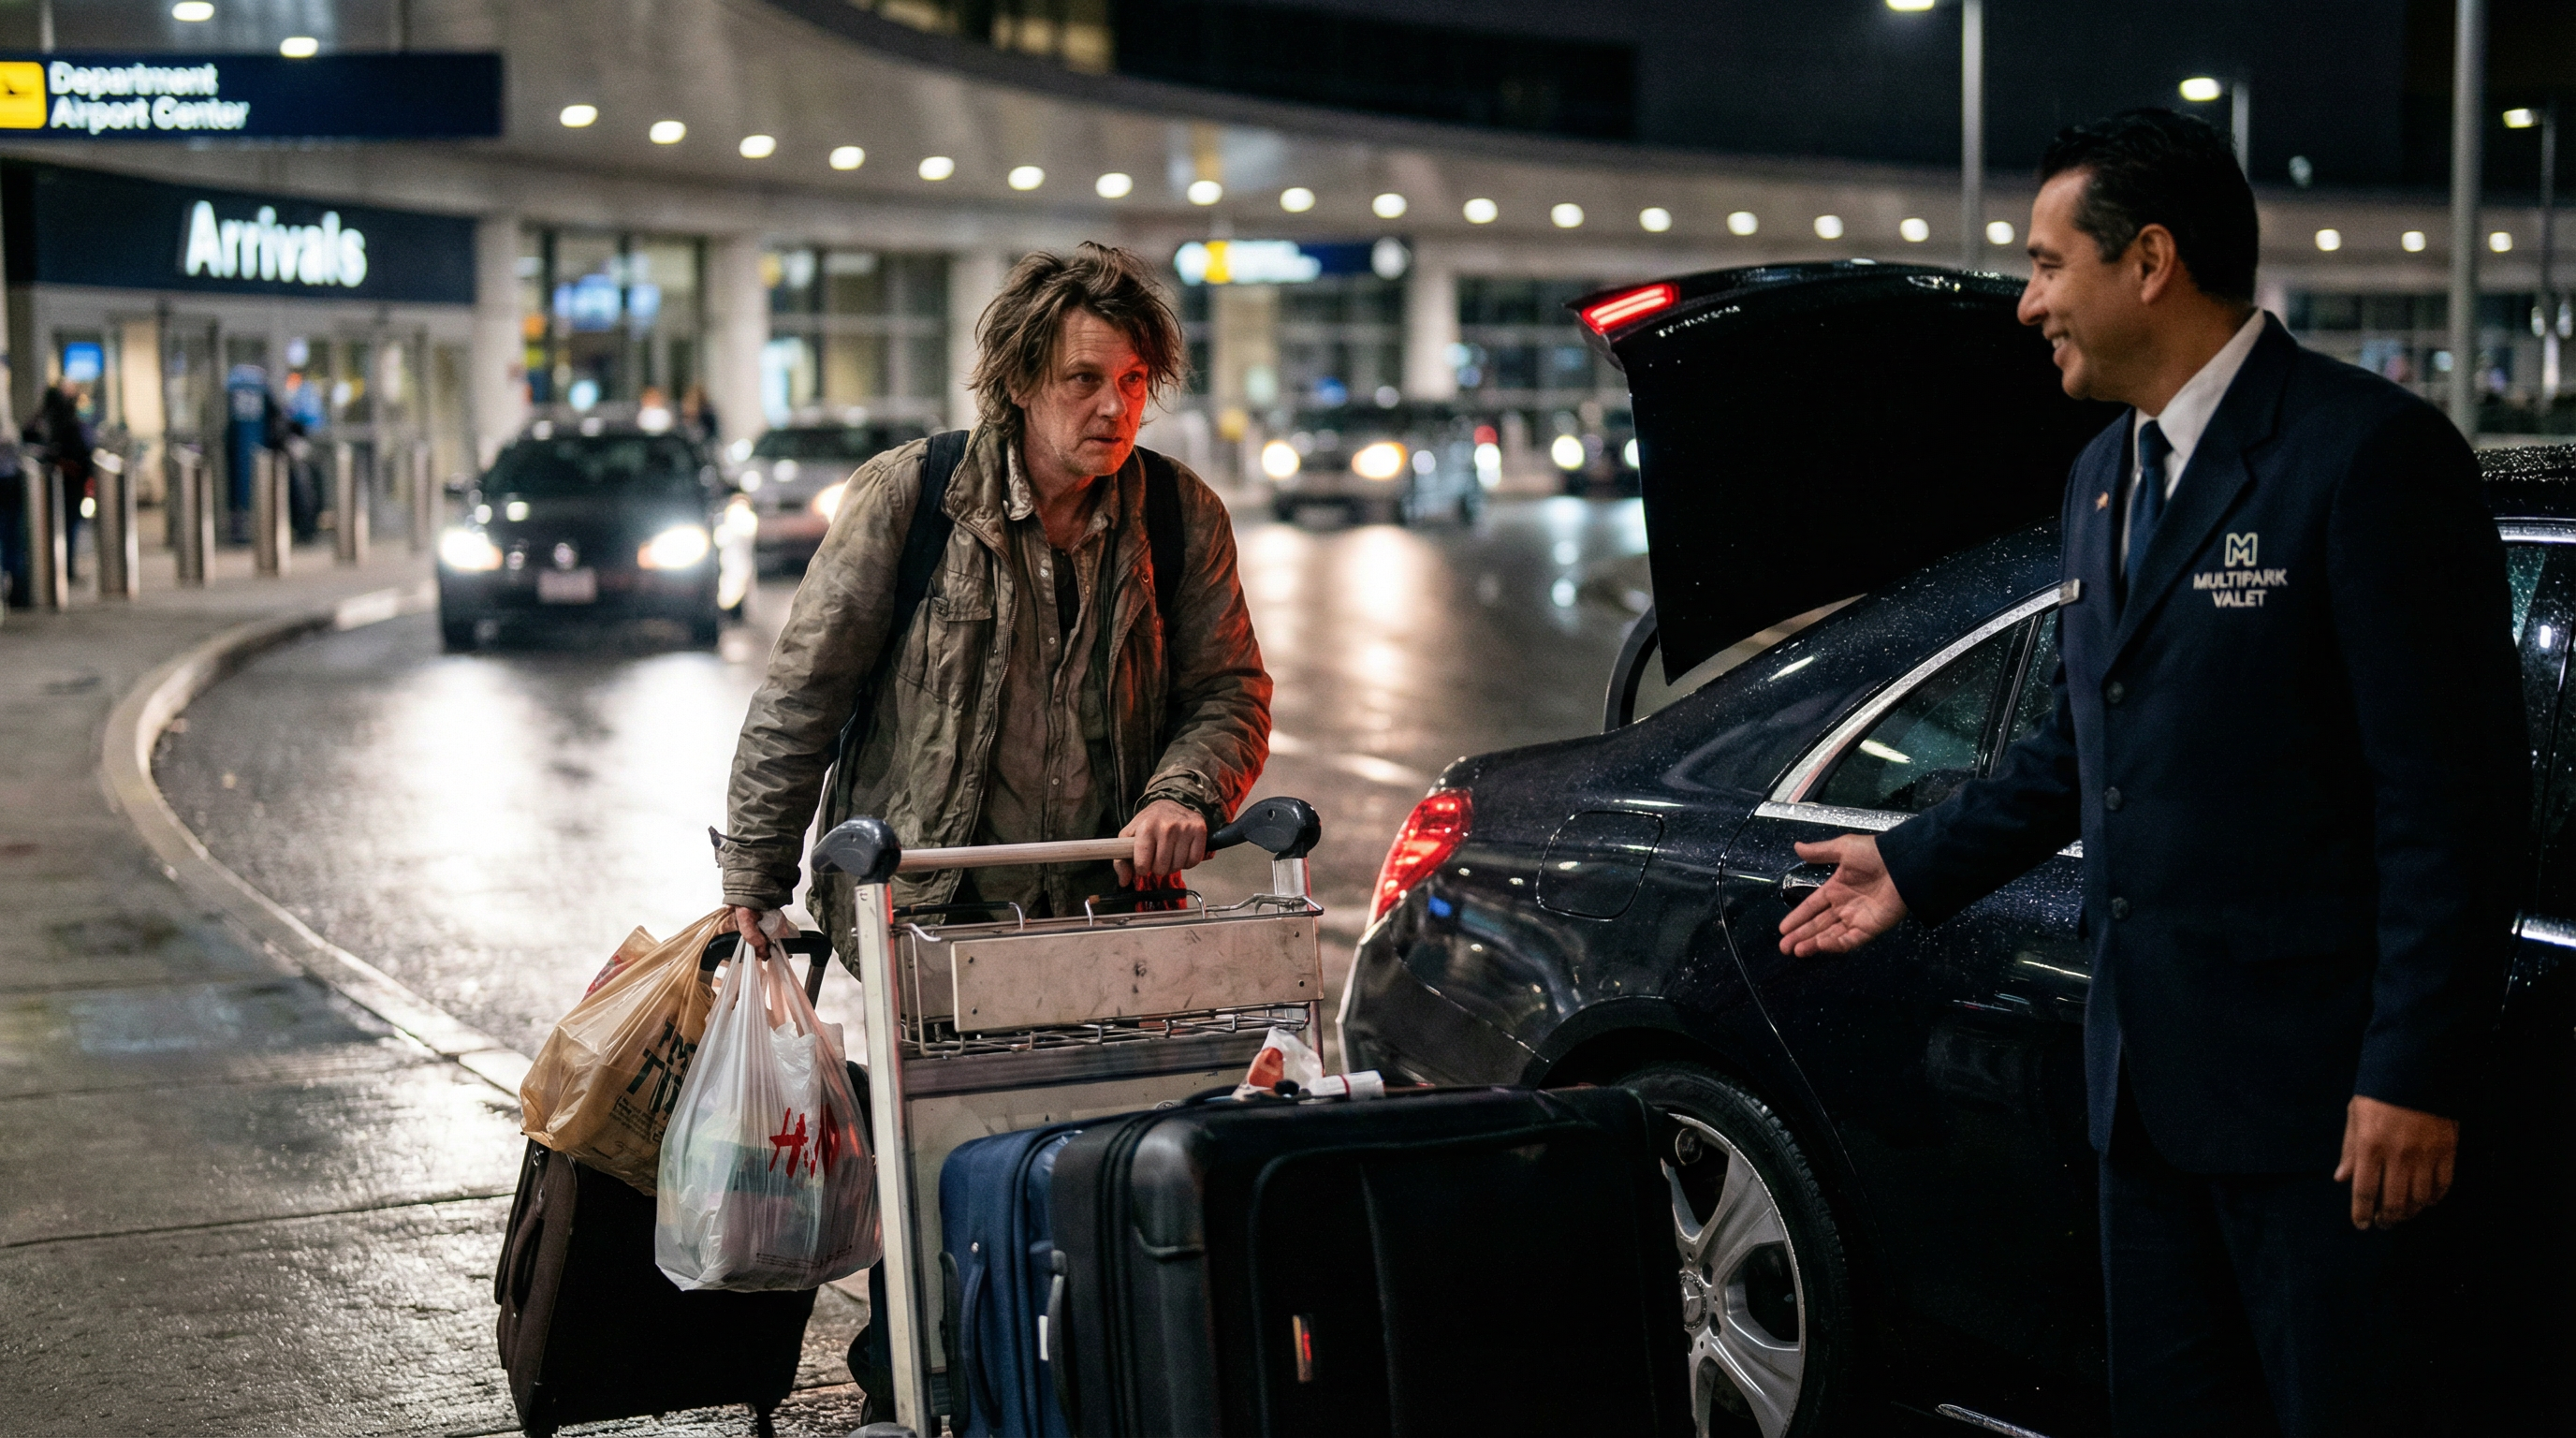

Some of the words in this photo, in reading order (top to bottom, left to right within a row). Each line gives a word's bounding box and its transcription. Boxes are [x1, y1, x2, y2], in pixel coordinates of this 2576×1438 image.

[49, 61, 219, 101] Department
[50, 95, 151, 136] Airport
[152, 95, 251, 130] Center
[185, 199, 368, 288] Arrivals
[2192, 567, 2289, 590] MULTIPARK
[2212, 589, 2268, 609] VALET
